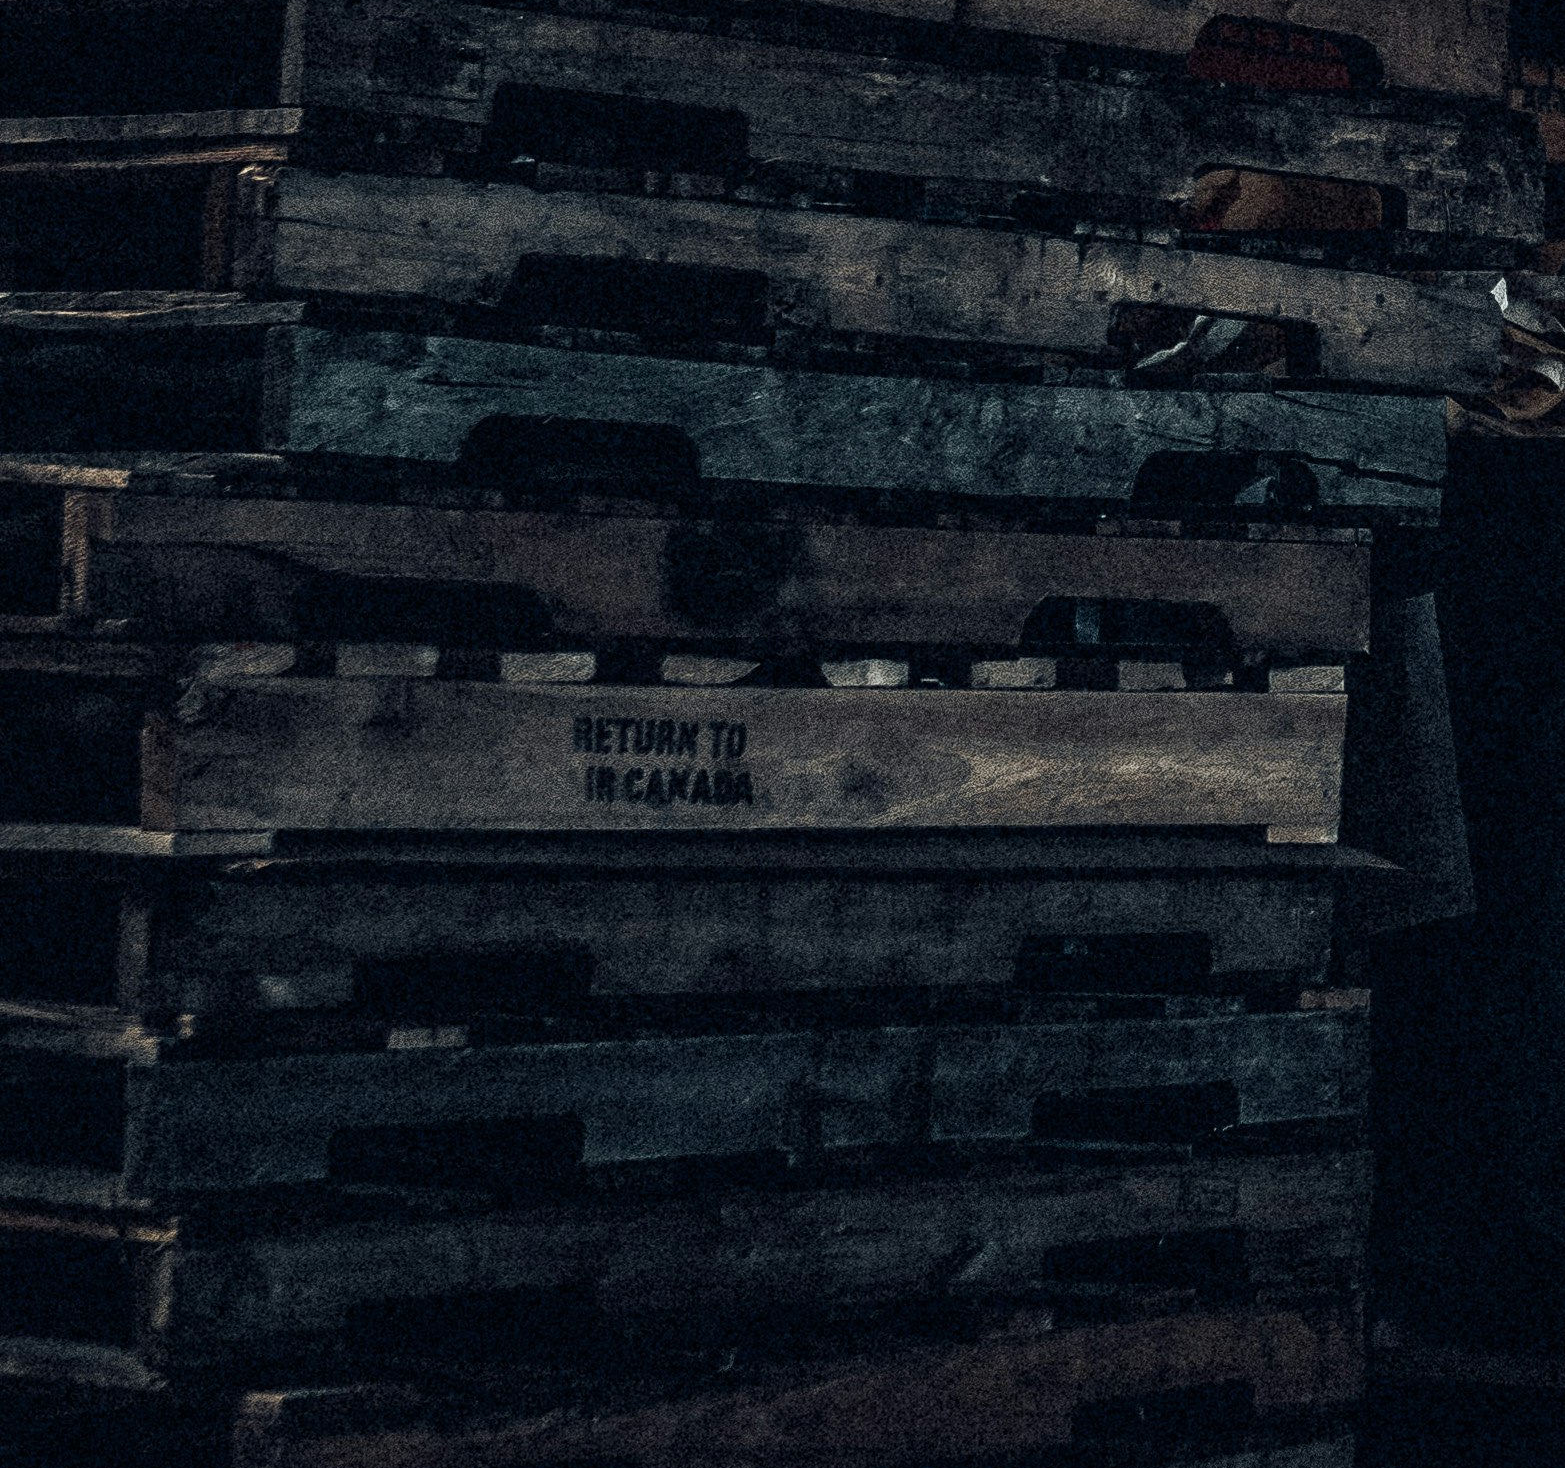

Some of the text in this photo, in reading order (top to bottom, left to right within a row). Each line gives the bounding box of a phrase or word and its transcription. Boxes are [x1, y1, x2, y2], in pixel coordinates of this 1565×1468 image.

[572, 716, 747, 758] RETURN TO
[623, 766, 754, 807] CANADA
